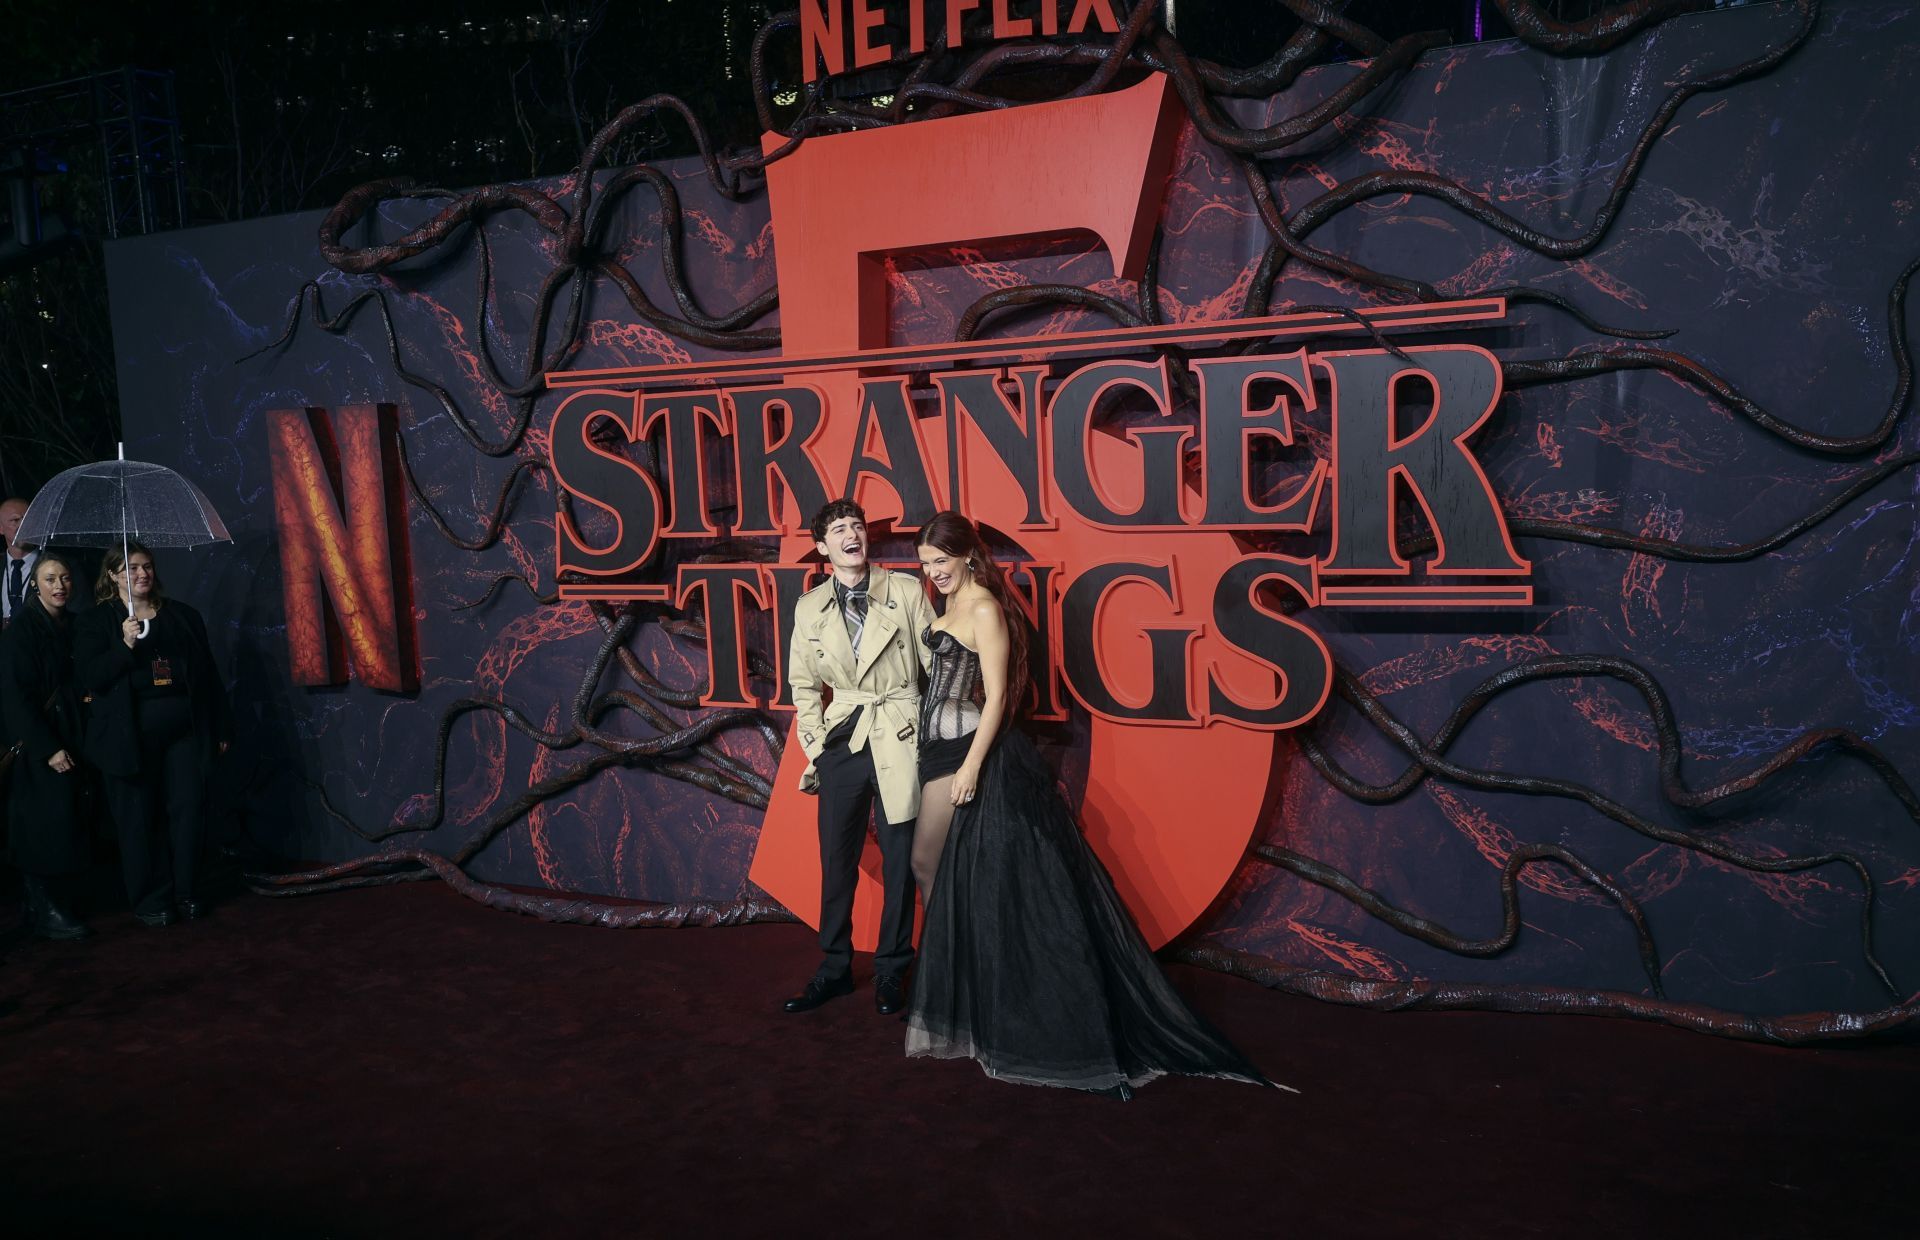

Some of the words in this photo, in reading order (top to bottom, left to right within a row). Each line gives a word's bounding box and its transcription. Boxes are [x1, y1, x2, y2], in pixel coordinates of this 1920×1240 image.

[265, 402, 404, 692] N
[548, 343, 1532, 580] STRANGER
[748, 71, 1280, 953] 5
